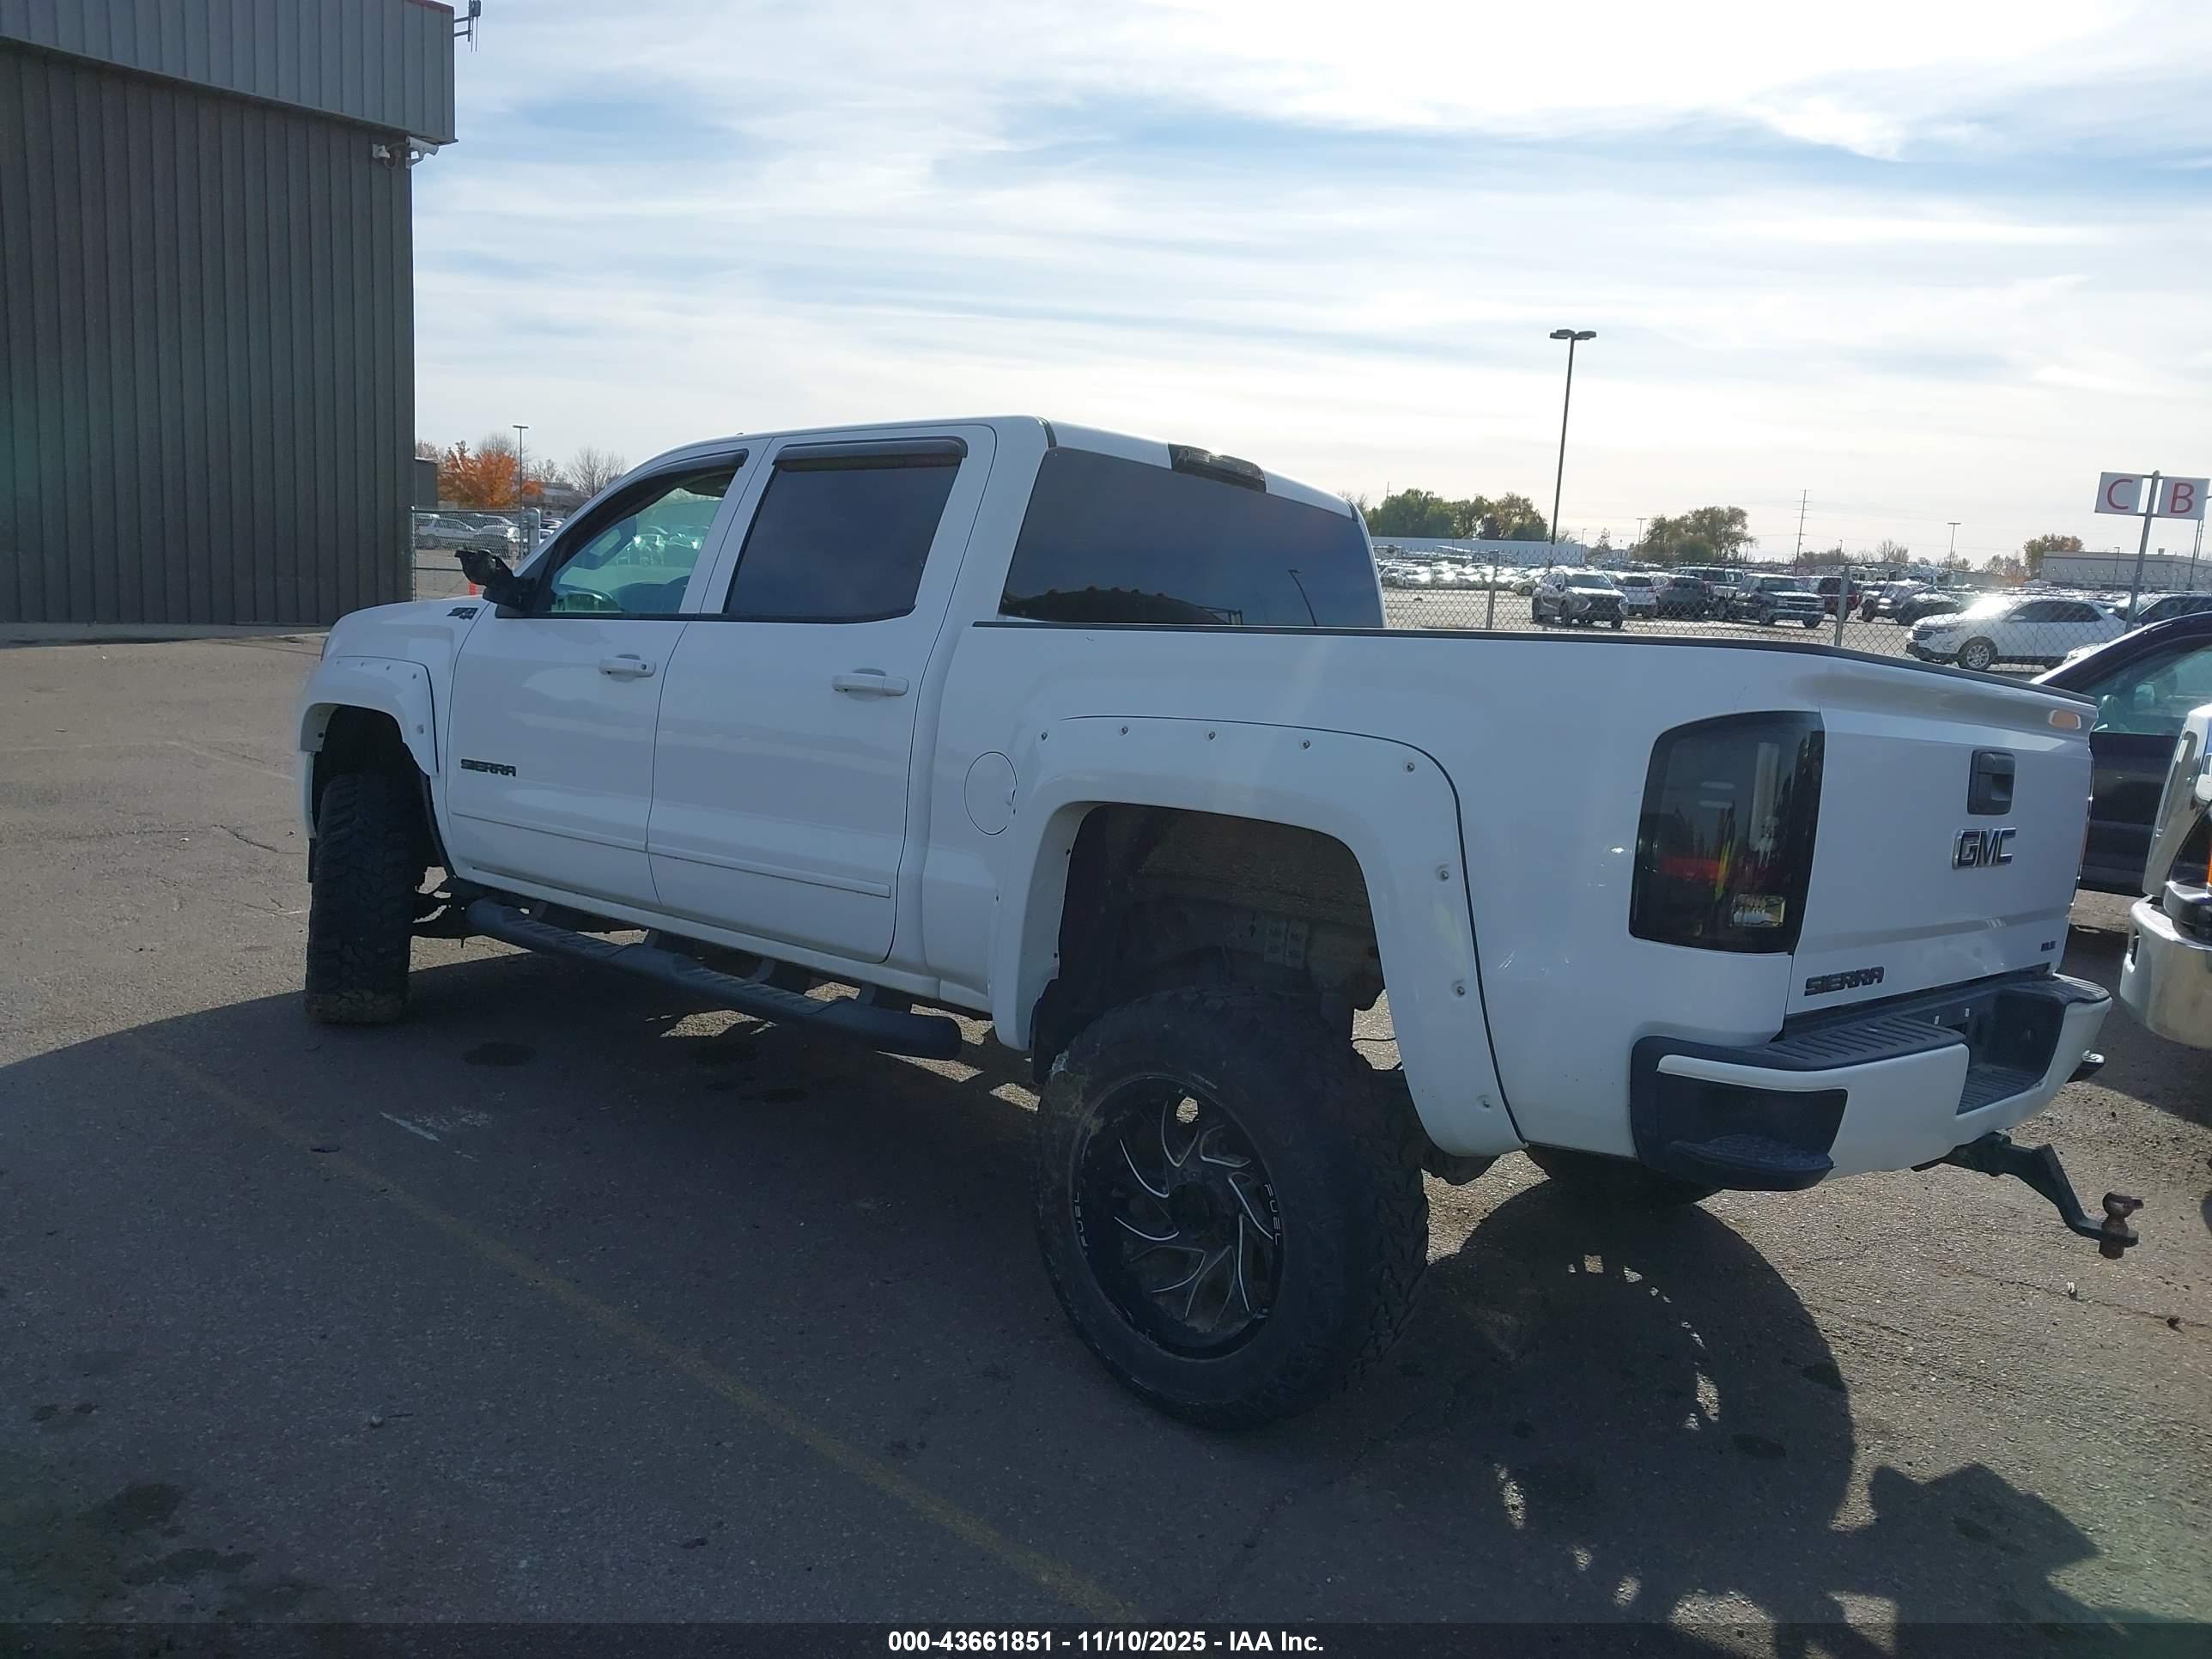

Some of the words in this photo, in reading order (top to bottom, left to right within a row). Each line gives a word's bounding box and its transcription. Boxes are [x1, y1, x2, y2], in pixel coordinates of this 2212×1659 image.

[2107, 478, 2133, 510] C
[2170, 482, 2195, 514] B
[460, 758, 517, 777] SIERRA
[1952, 827, 2017, 869] GMC
[1804, 966, 1885, 997] SIERRA
[1264, 1183, 1282, 1246] FUEL
